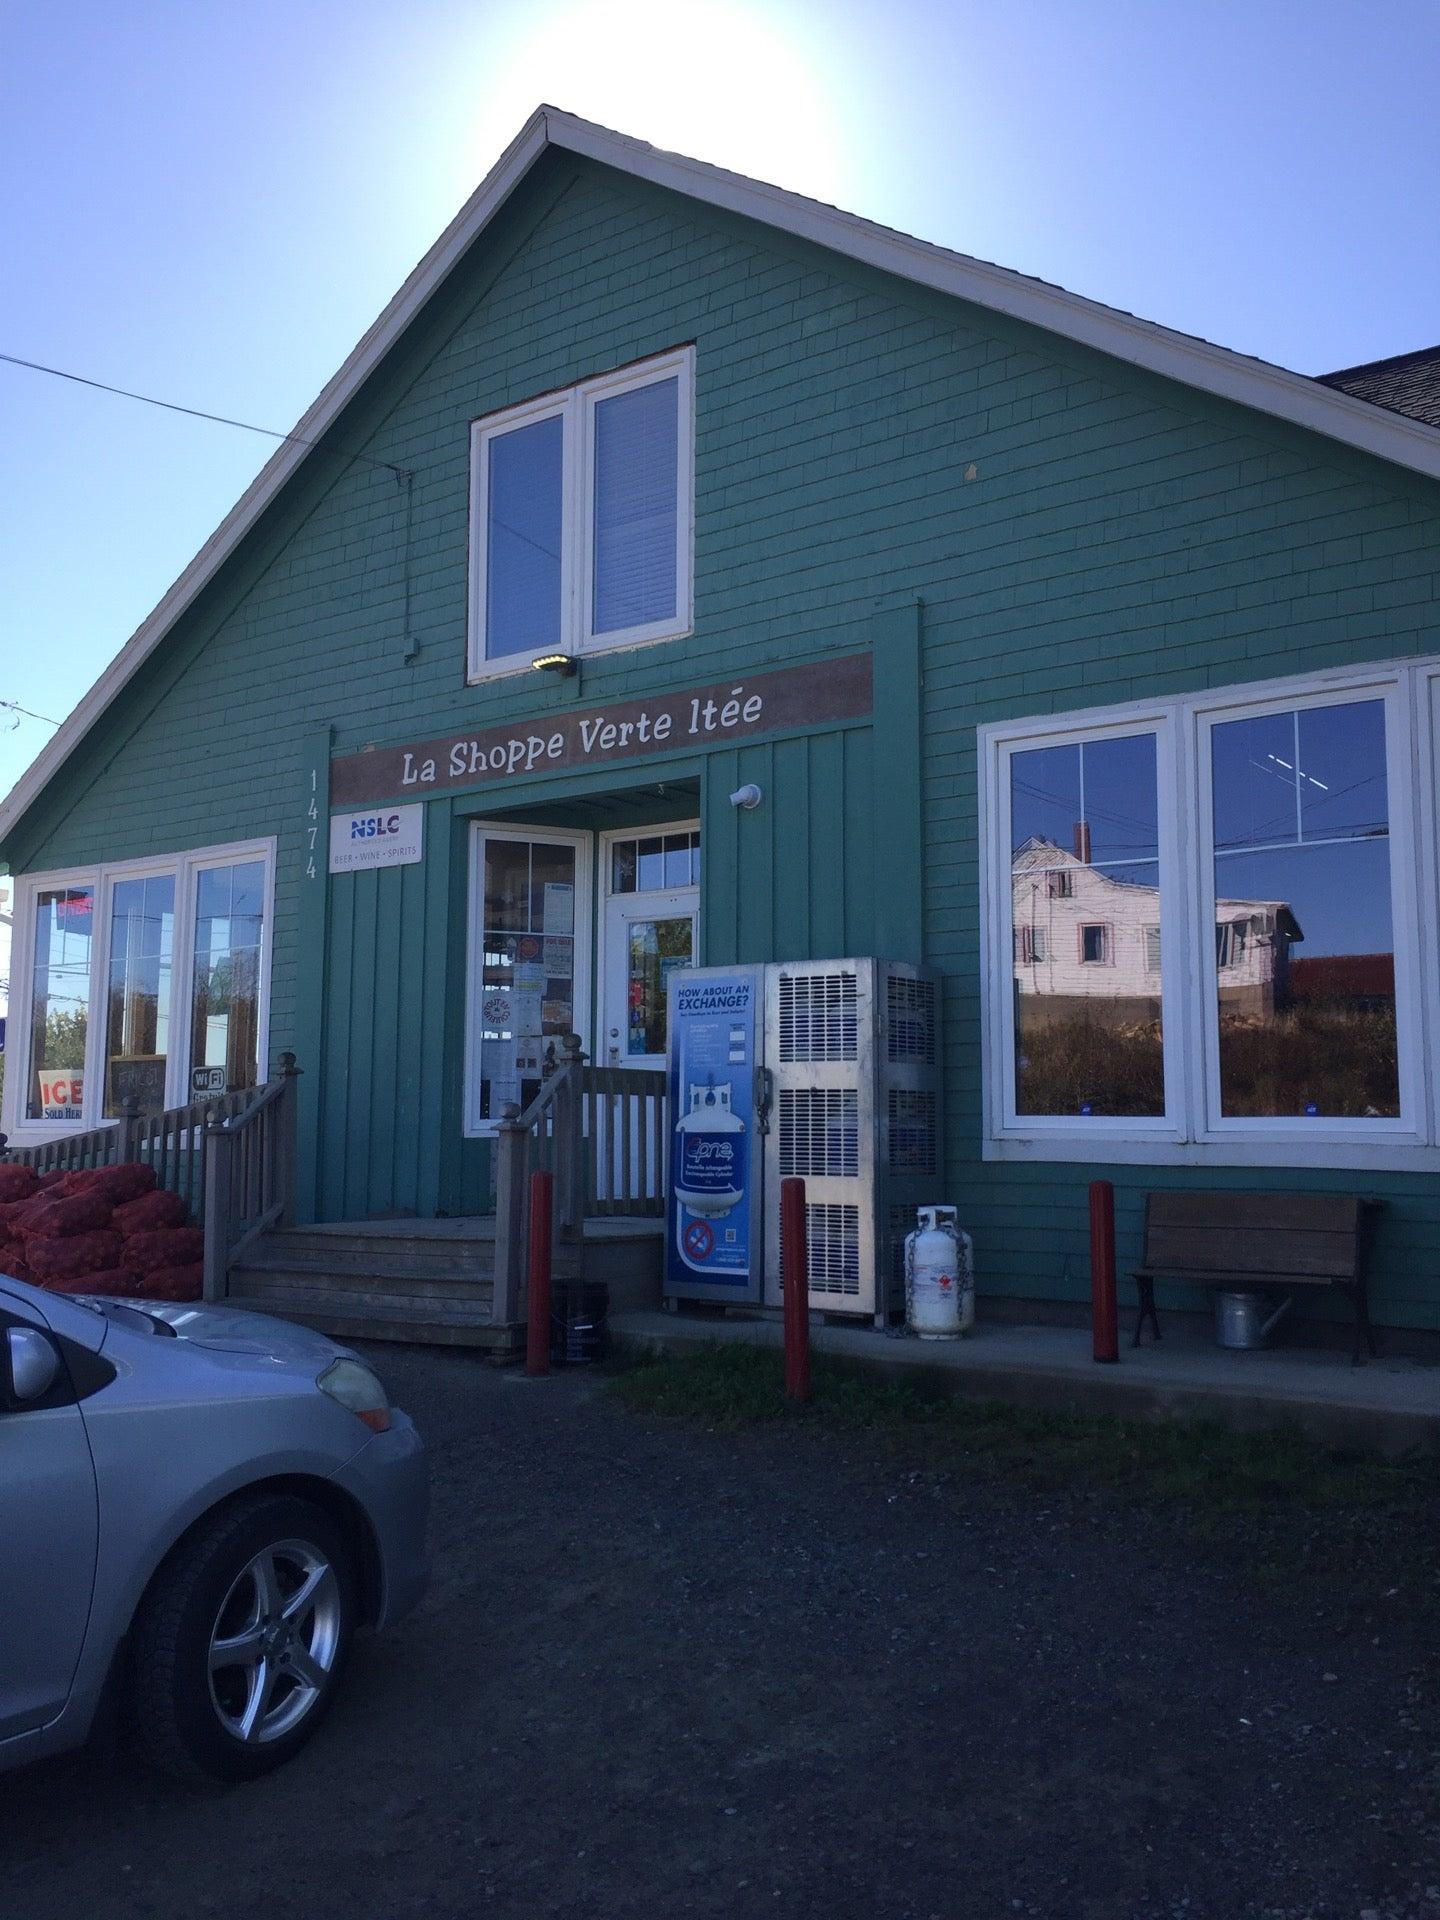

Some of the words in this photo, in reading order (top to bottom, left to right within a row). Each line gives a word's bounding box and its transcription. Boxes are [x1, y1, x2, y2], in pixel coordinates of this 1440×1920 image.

[402, 754, 435, 785] La
[449, 732, 565, 776] Shoppe
[579, 712, 671, 753] Verte
[306, 769, 319, 878] 1474
[351, 815, 400, 839] NSLC
[334, 855, 353, 864] BEER
[360, 851, 380, 861] WINE
[388, 846, 417, 858] SPIRITS
[678, 989, 701, 998] HOW
[702, 986, 734, 996] ABOUT
[735, 985, 750, 994] AN
[678, 995, 750, 1010] EXCHANGE?
[43, 1080, 83, 1105] ICE
[45, 1108, 63, 1120] SOLD
[65, 1108, 82, 1120] HER
